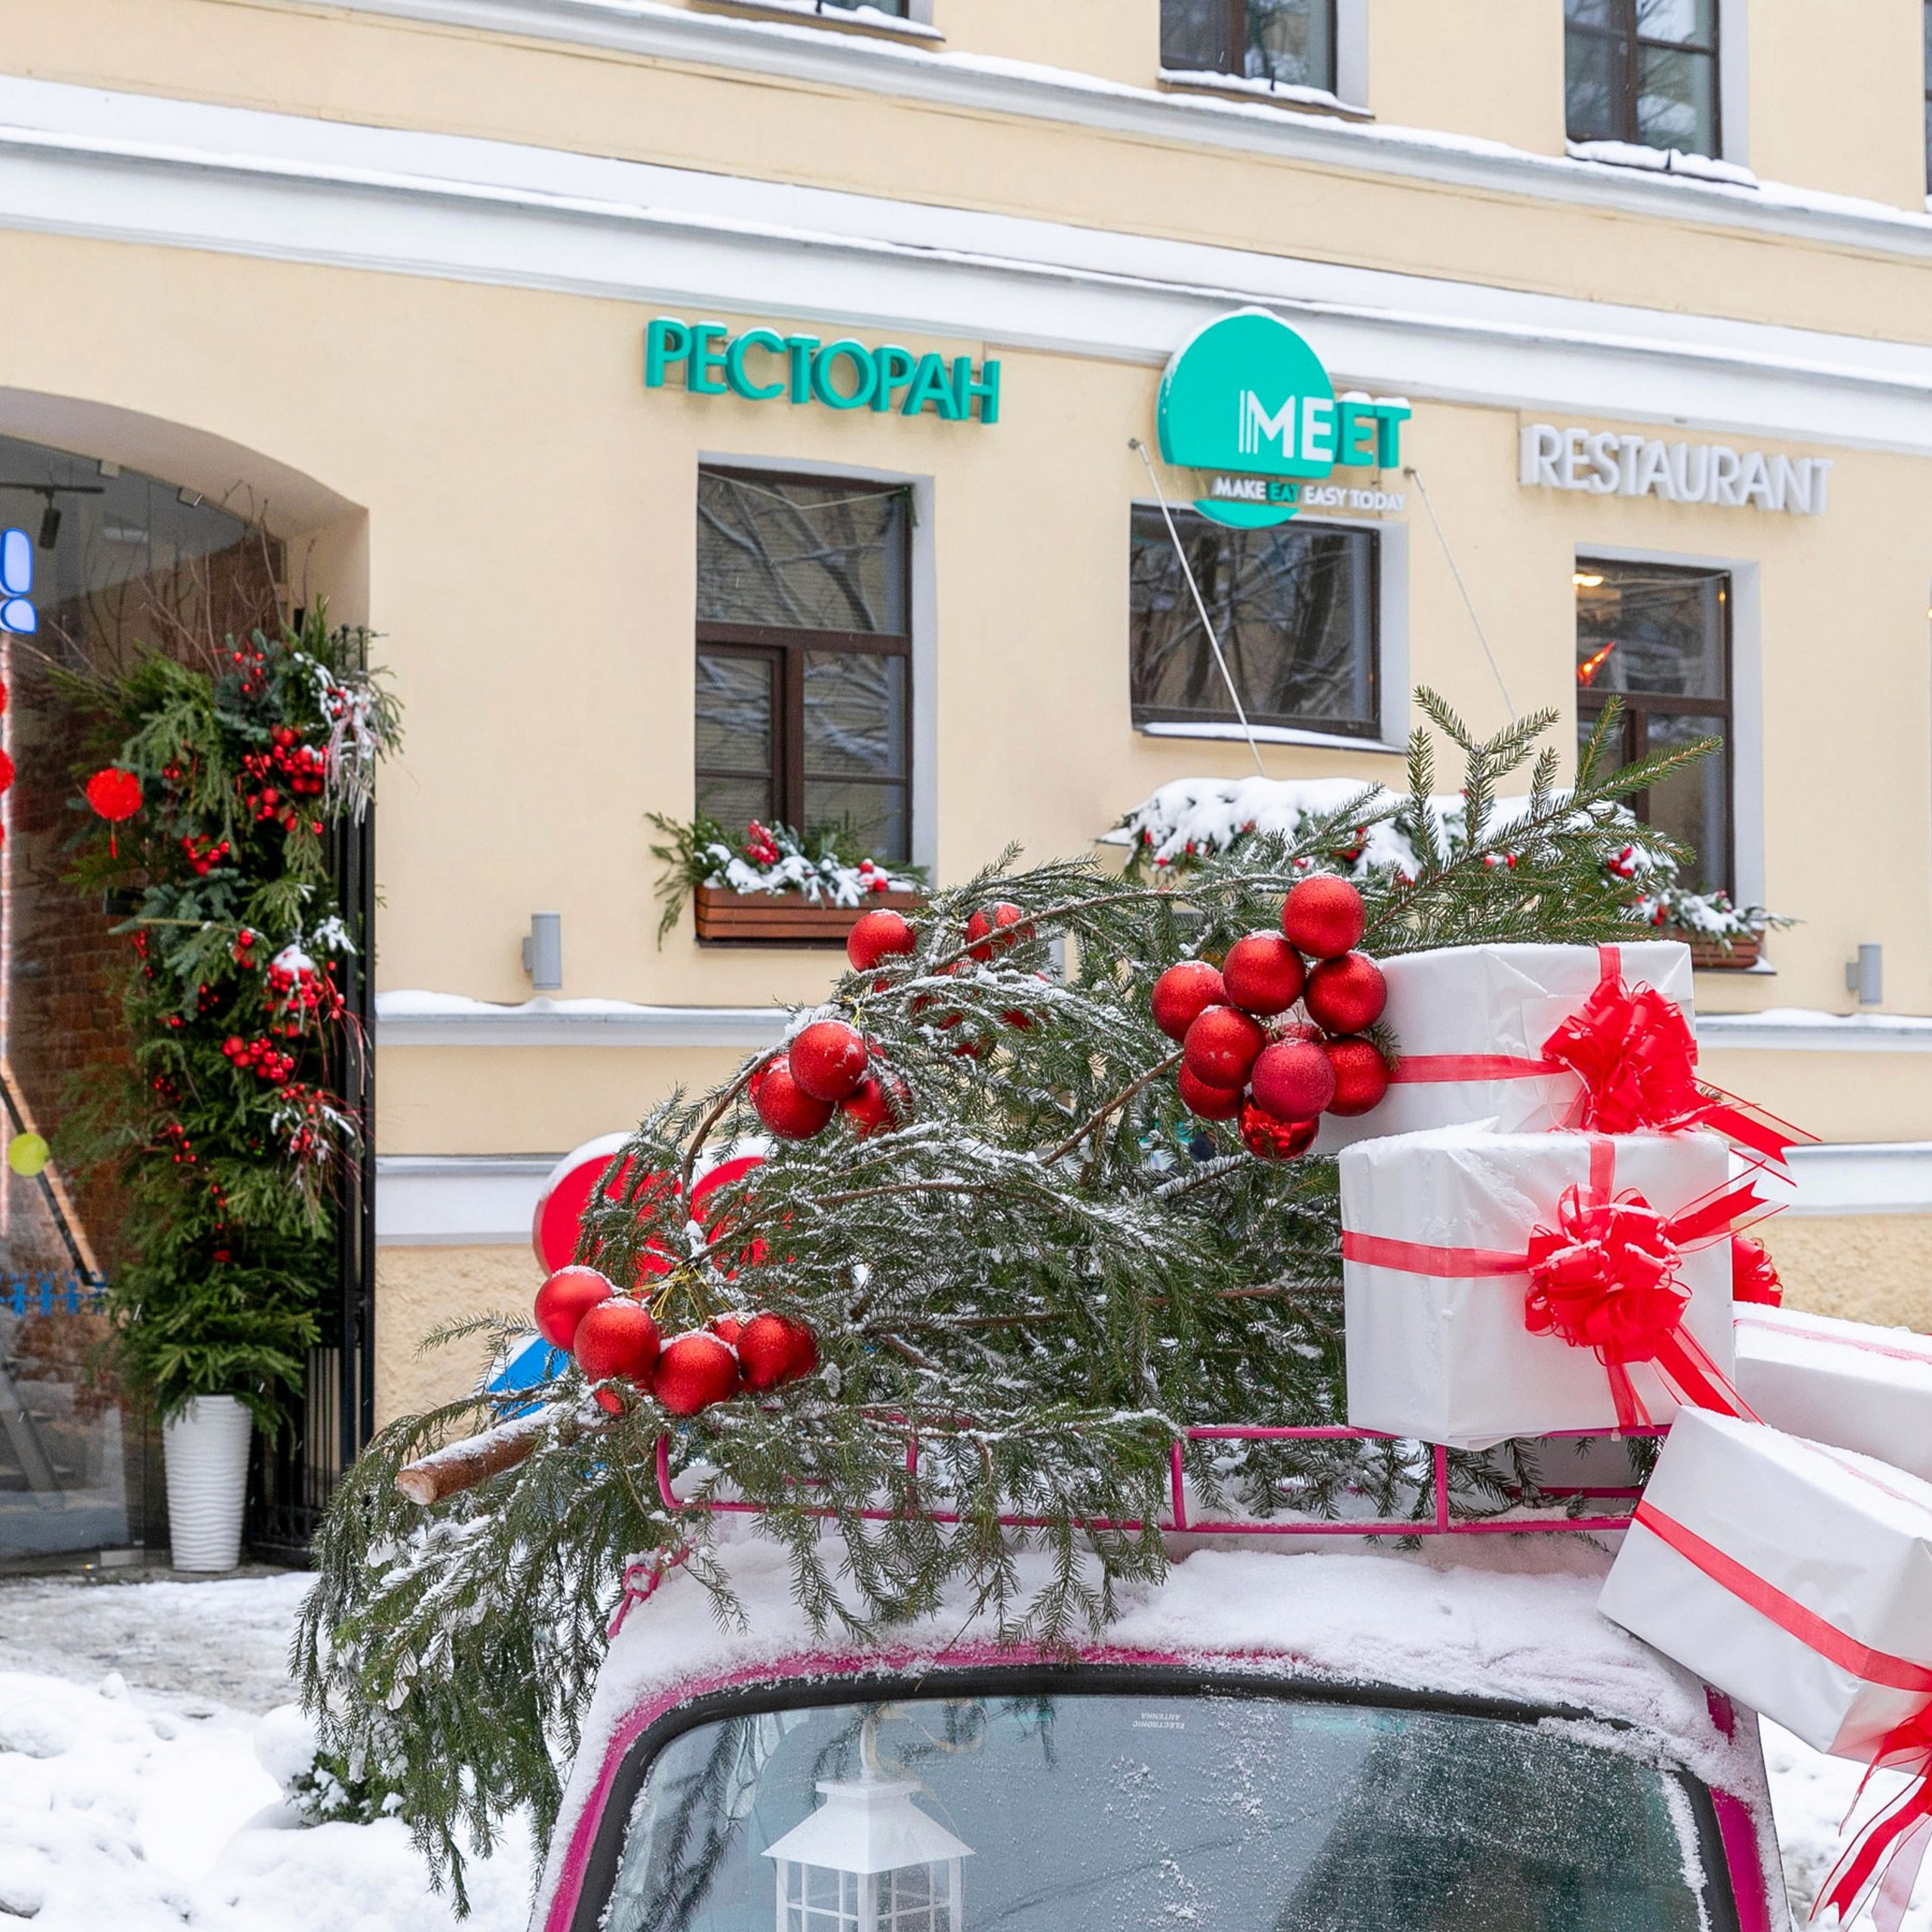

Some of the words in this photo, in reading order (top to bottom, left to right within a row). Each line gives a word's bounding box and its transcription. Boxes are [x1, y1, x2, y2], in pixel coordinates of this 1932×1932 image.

[645, 317, 1000, 424] РЕСТОРАН
[1238, 389, 1411, 469] MEET
[1214, 476, 1267, 500] MAKE
[1267, 481, 1300, 503] EAT
[1303, 485, 1348, 507] EASY
[1349, 488, 1406, 512] TODAY
[1518, 423, 1835, 515] RESTAURANT
[1132, 1721, 1185, 1730] ELECTRONIC
[1140, 1712, 1181, 1721] ANTENNA
